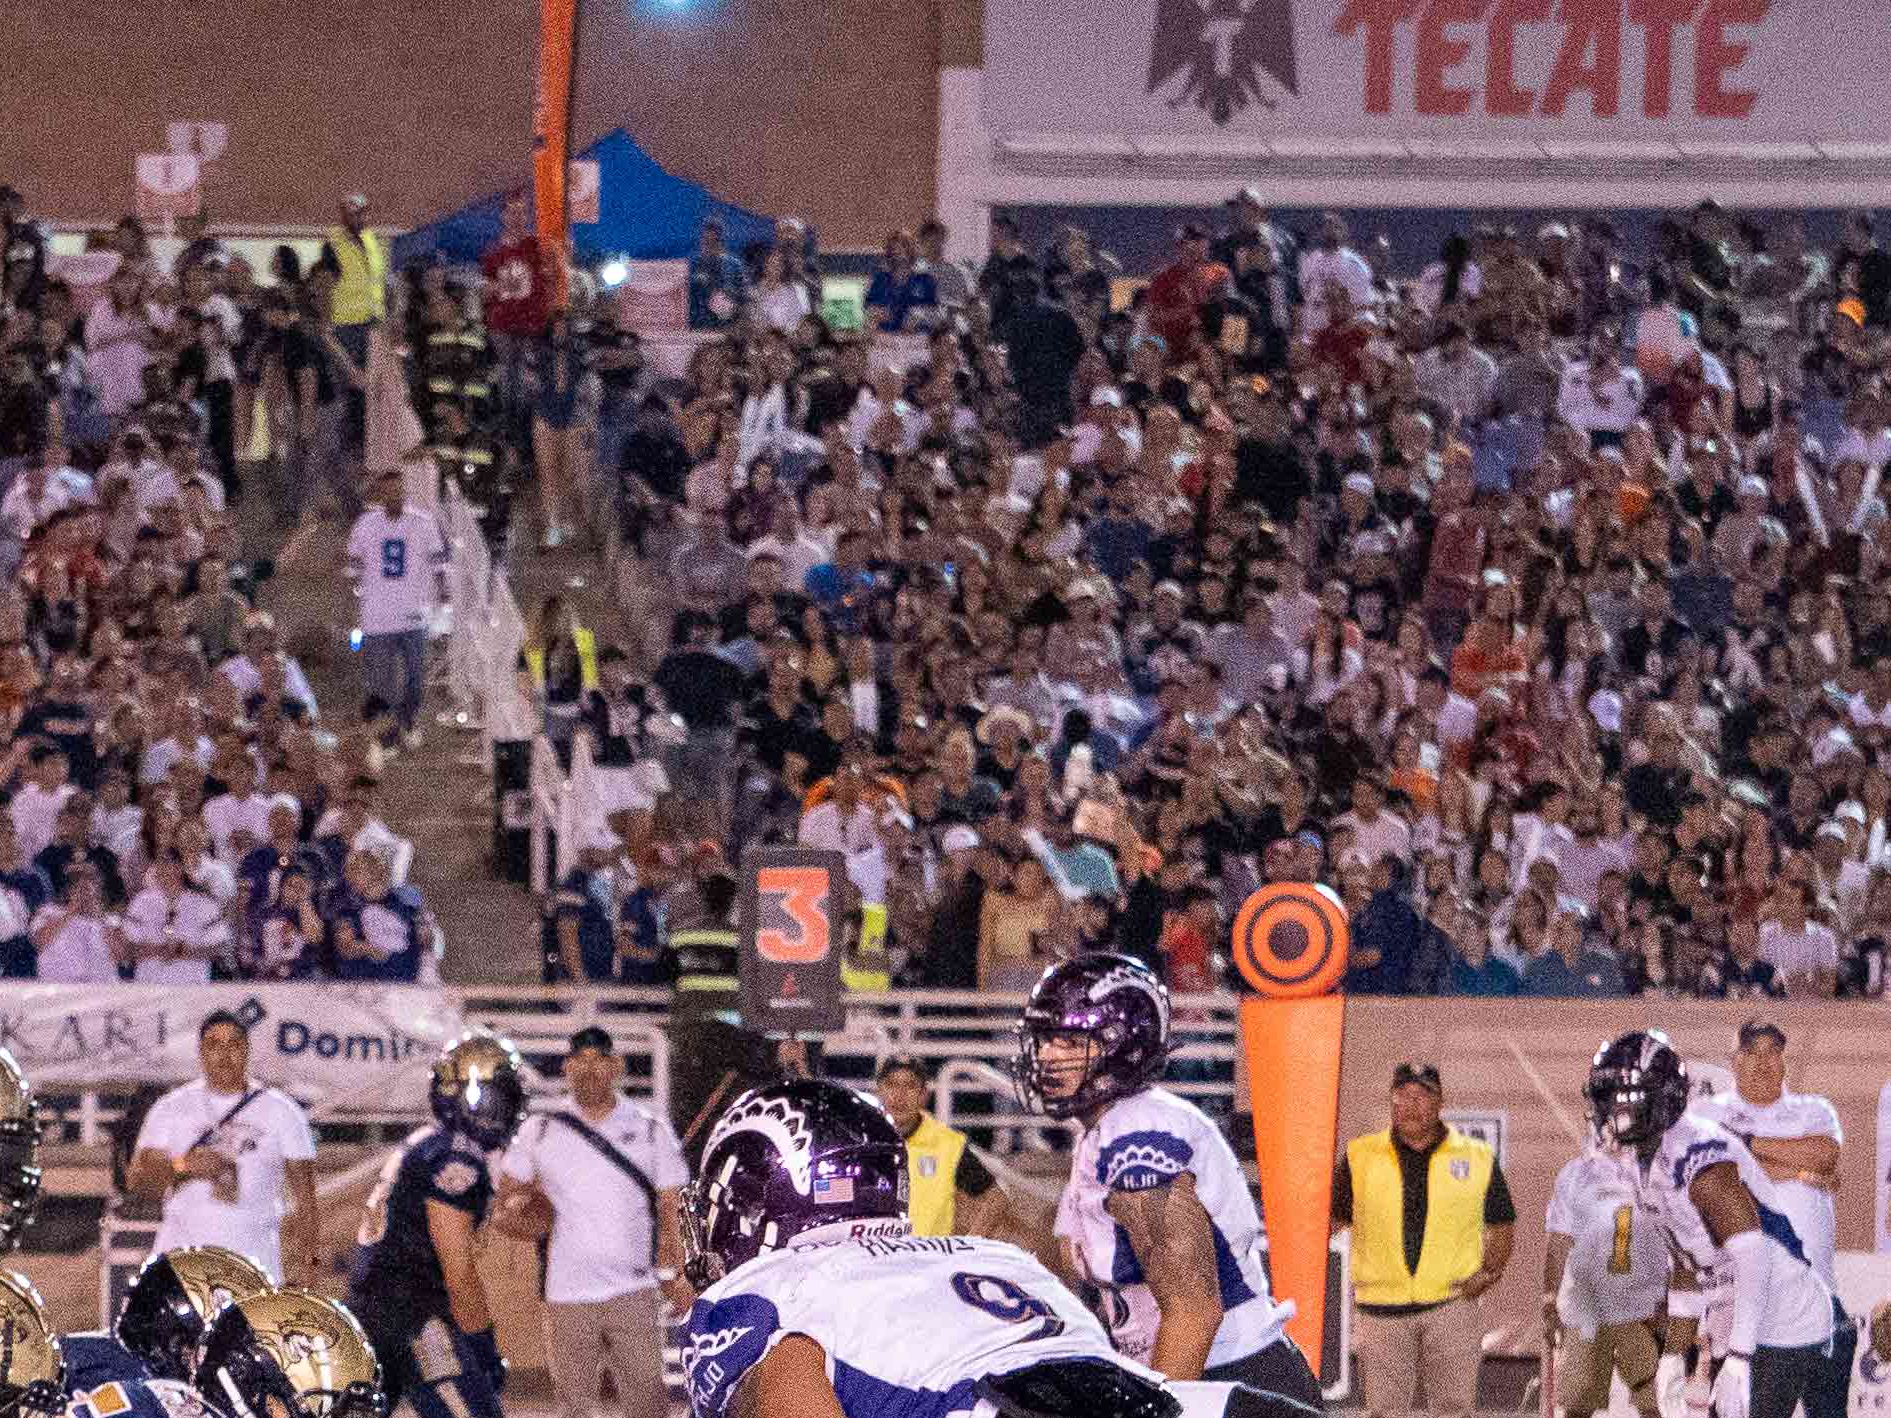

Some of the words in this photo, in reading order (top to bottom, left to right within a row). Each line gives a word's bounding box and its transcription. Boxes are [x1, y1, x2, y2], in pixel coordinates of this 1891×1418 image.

[1332, 0, 1771, 118] TECATE
[381, 538, 406, 578] 9
[756, 866, 830, 963] 3
